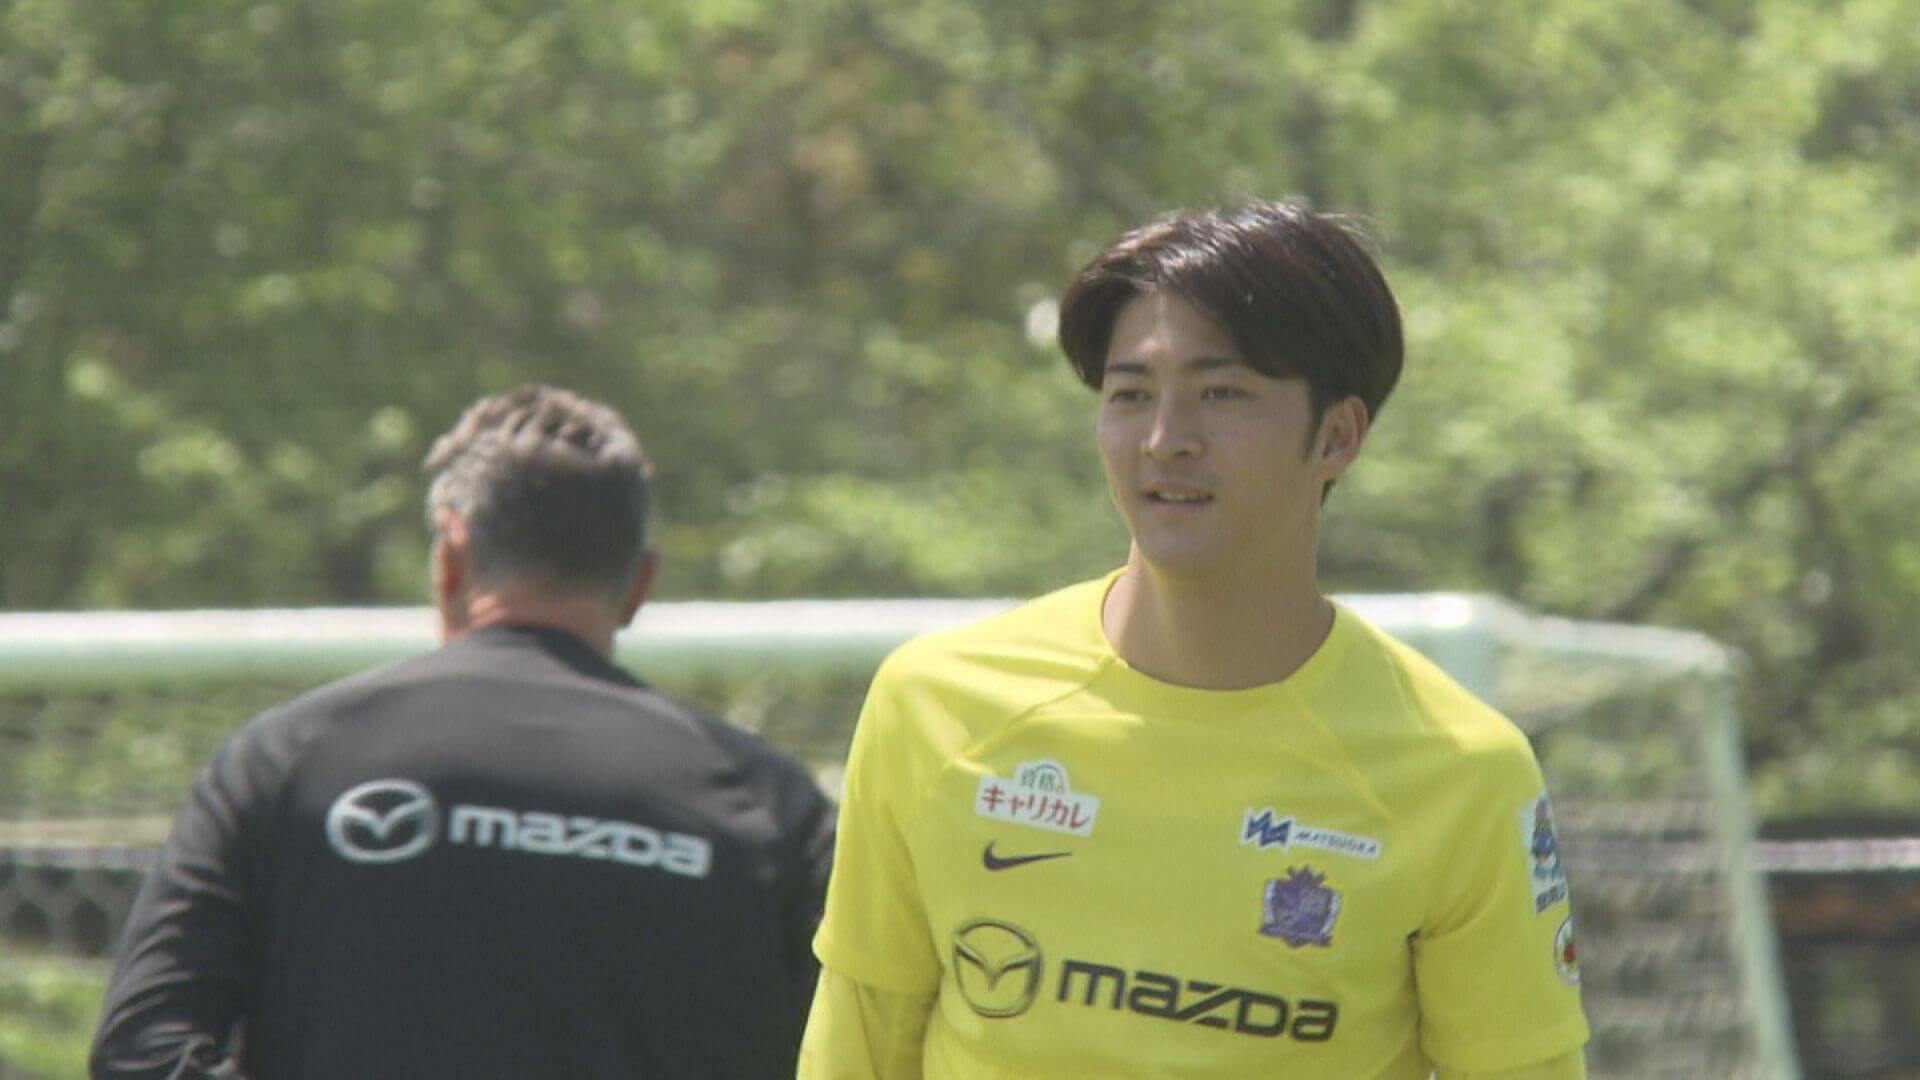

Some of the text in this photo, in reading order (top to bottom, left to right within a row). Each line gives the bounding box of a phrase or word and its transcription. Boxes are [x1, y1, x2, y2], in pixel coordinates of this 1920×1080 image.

[981, 784, 1091, 828] キャリカレ
